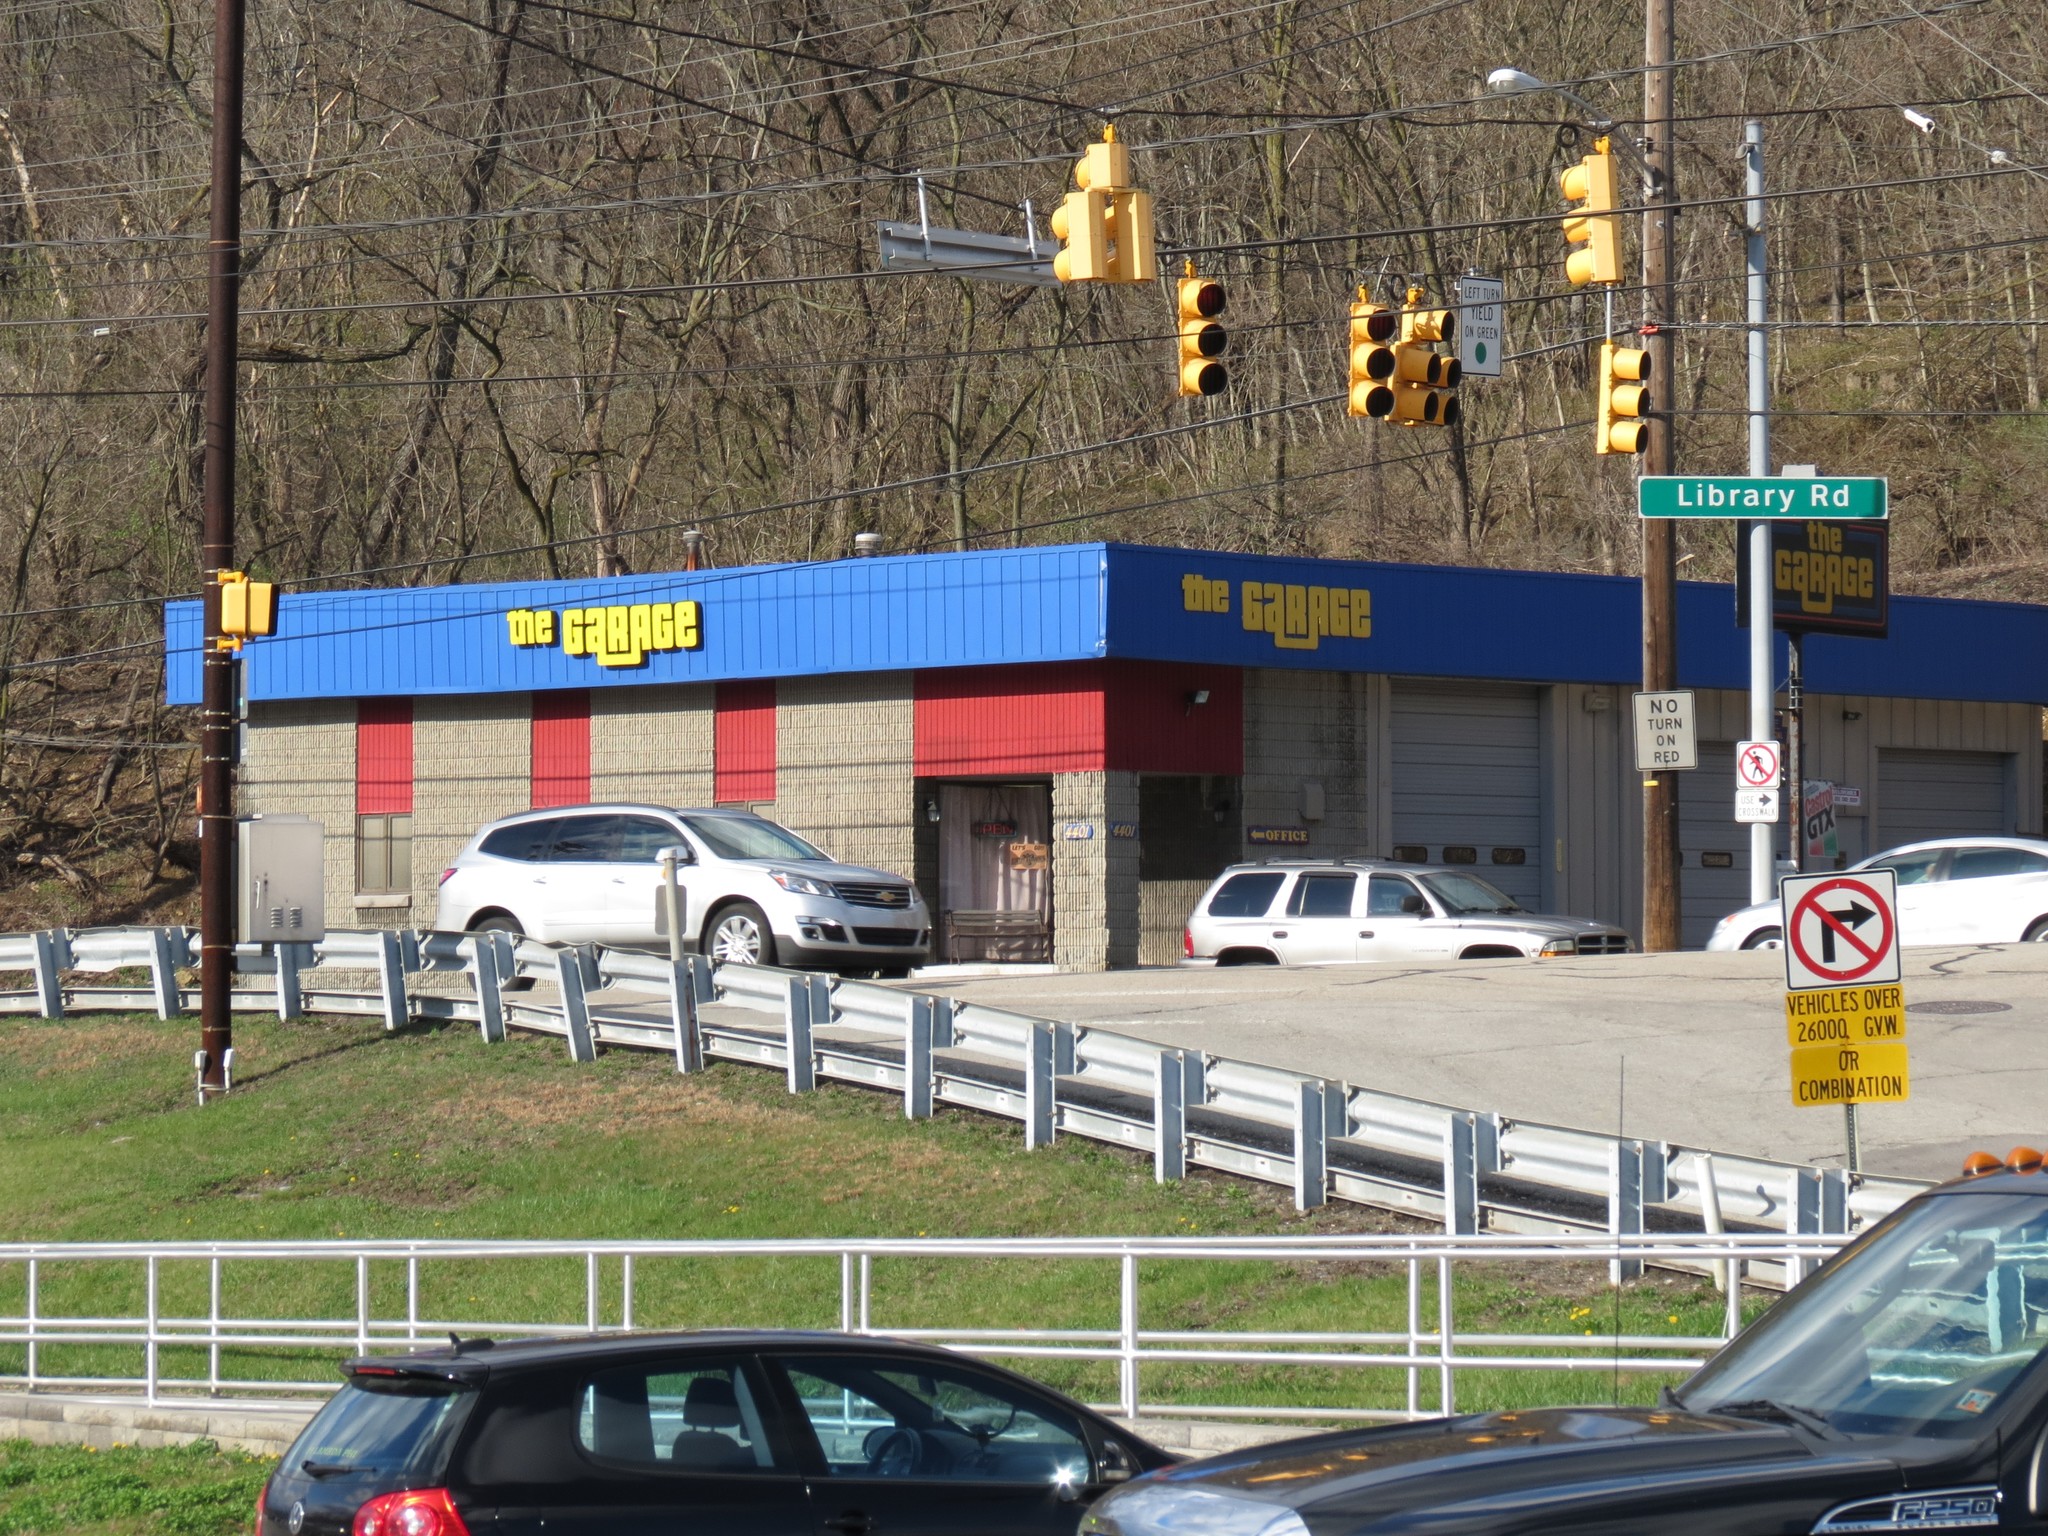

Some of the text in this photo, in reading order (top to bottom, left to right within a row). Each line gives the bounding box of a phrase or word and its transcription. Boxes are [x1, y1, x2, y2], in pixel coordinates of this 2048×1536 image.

[1464, 287, 1500, 300] LEFT TURN
[1471, 305, 1493, 321] YIELD
[1464, 325, 1498, 340] ON GREEN
[1678, 483, 1849, 512] Library Rd
[1807, 520, 1842, 552] the
[1182, 573, 1230, 613] the
[507, 609, 553, 645] the
[1651, 699, 1678, 714] NO
[1648, 718, 1682, 730] TURN
[1656, 735, 1675, 746] ON
[1654, 751, 1679, 763] RED
[1741, 796, 1754, 804] USE
[1806, 785, 1833, 817] Castrol
[1738, 807, 1775, 817] CROSSWALK
[1807, 804, 1834, 839] GTX
[1065, 824, 1088, 838] 4401
[1113, 825, 1134, 837] 4401
[1266, 830, 1307, 841] OFFICE
[1787, 988, 1901, 1016] VEHICLES OVER
[1839, 1050, 1859, 1071] OR
[1800, 1075, 1902, 1101] COMBINATION
[1897, 1517, 1994, 1529] SUPER DUTY
